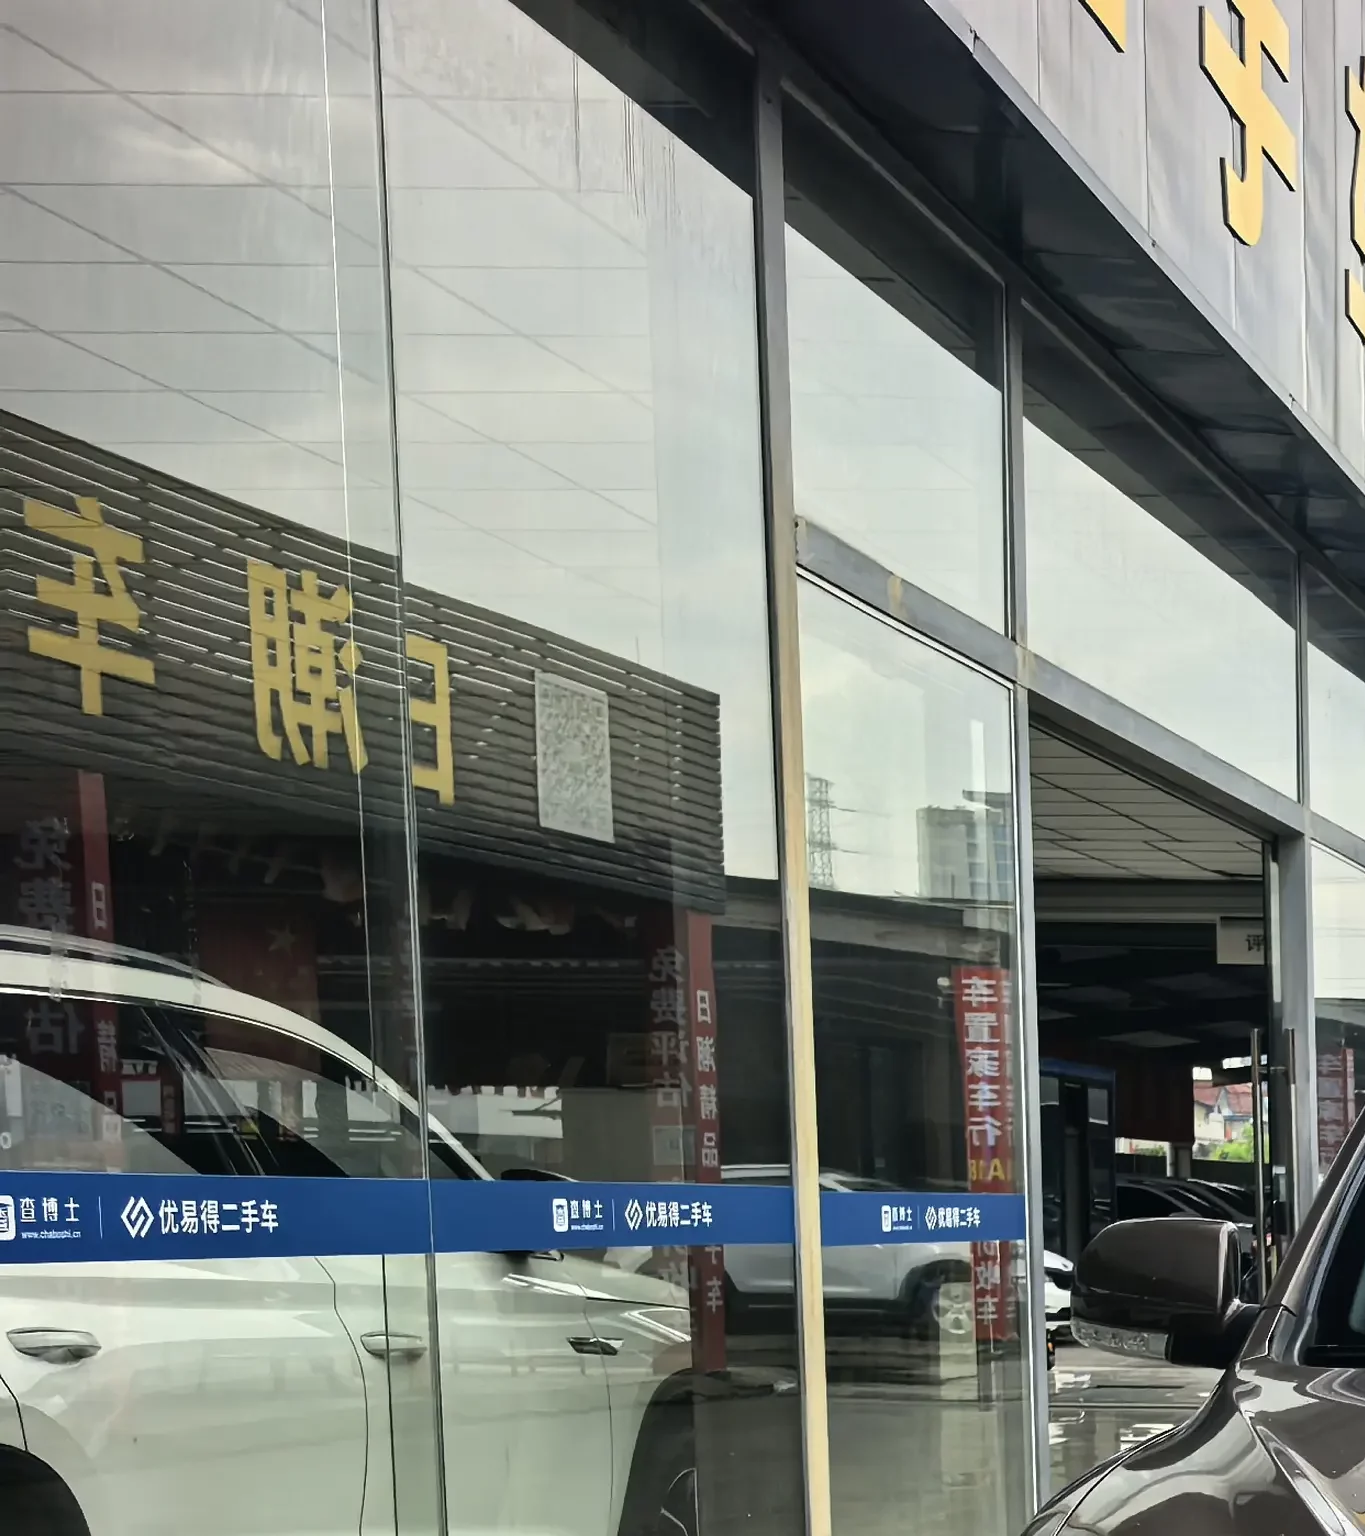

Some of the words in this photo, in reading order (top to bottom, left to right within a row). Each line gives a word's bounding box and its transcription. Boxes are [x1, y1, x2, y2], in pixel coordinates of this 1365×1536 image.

[158, 1198, 280, 1235] 优易得二手车
[645, 1200, 713, 1229] 优易得二手车
